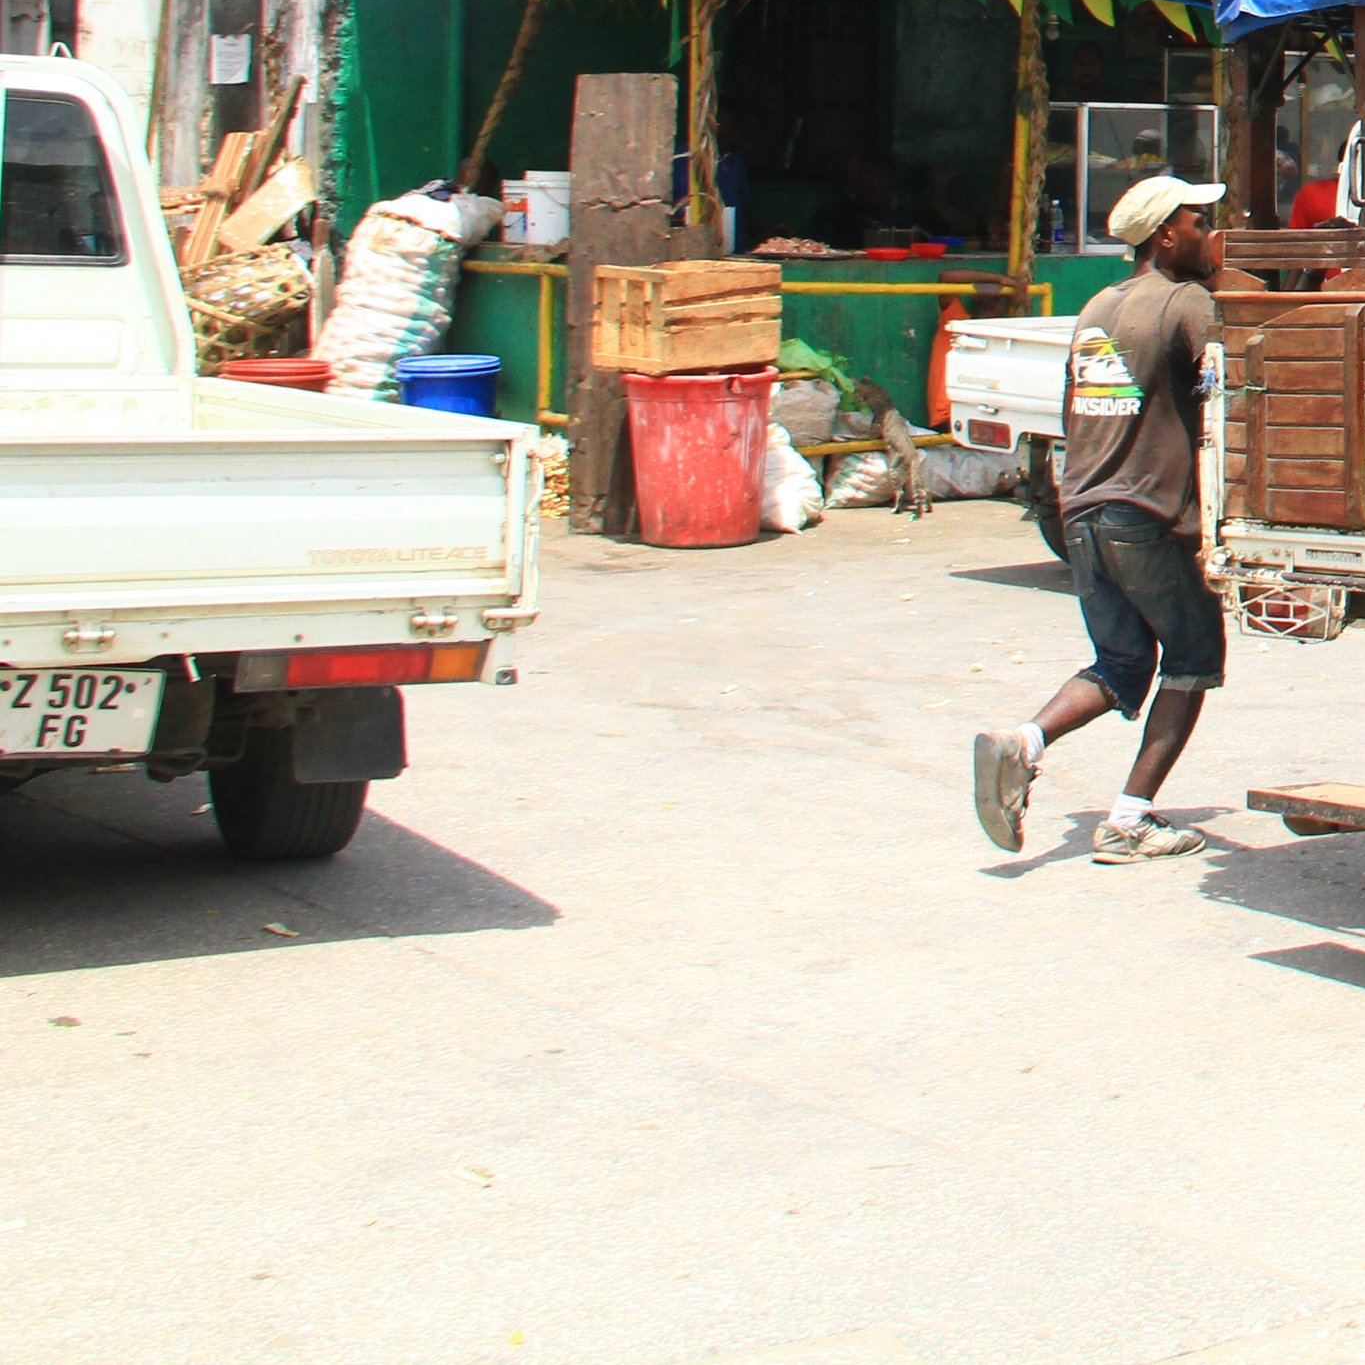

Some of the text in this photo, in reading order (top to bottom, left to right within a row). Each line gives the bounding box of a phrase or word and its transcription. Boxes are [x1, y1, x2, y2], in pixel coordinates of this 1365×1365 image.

[309, 547, 392, 565] TOYOTA
[11, 672, 121, 710] Z 502
[36, 713, 88, 748] FG
